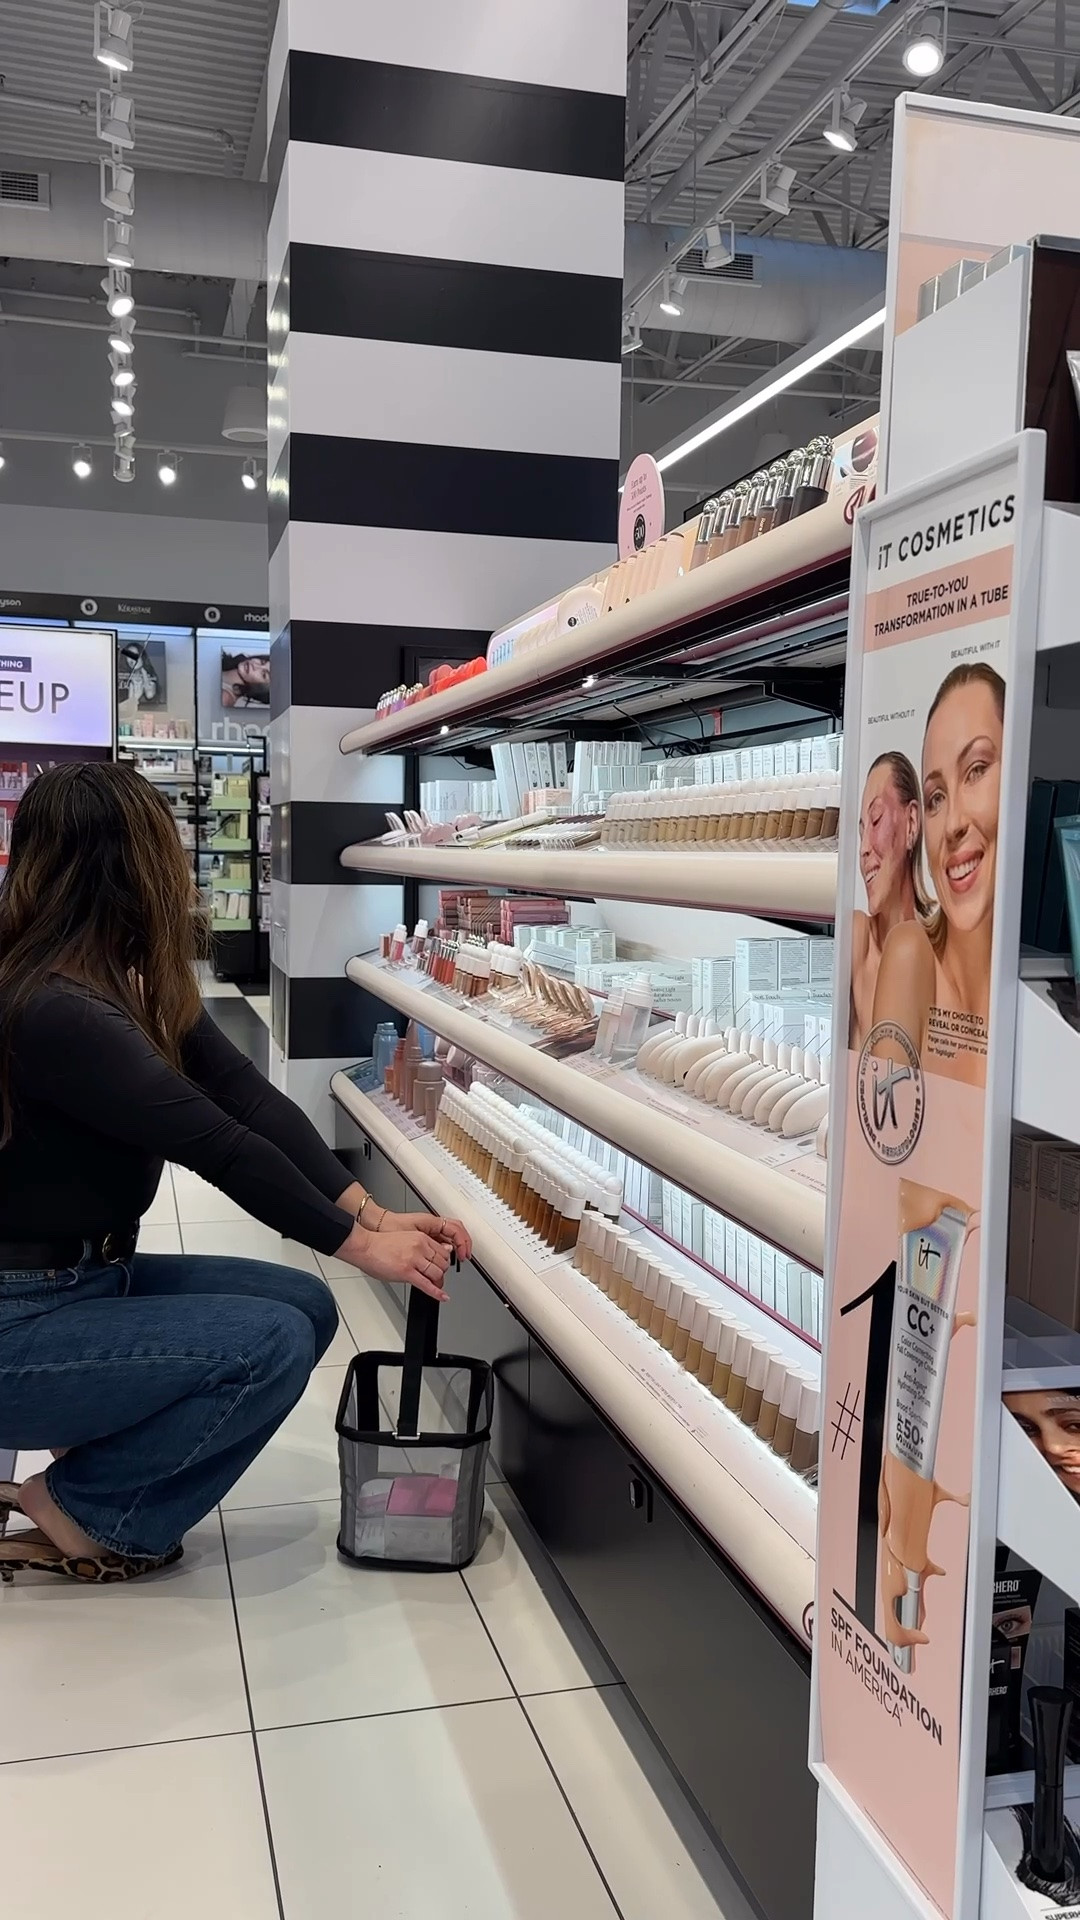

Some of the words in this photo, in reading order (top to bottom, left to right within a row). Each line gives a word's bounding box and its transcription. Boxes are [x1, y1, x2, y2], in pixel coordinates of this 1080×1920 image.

[898, 495, 1015, 562] COSMETICS
[906, 576, 969, 608] TRUE-TO-YOU
[874, 602, 954, 637] TRANSFORMATION
[957, 596, 967, 611] IN
[970, 594, 977, 608] A
[981, 584, 1009, 606] TUBE
[950, 646, 978, 659] BEAUTIFUL
[980, 641, 995, 652] WITH
[995, 640, 1001, 650] IT
[868, 713, 890, 725] BEAUTIFUL
[890, 710, 910, 722] WITHOUT
[910, 709, 916, 718] IT
[928, 1018, 950, 1031] REVEAL
[951, 1022, 960, 1032] OR
[942, 1009, 951, 1019] MY
[952, 1010, 974, 1025] CHOICE
[975, 1015, 984, 1026] TO
[918, 1238, 941, 1270] it
[907, 1304, 935, 1338] CC+
[896, 1412, 904, 1443] SPF
[831, 1631, 842, 1658] IN
[831, 1607, 852, 1641] SPF
[856, 1632, 942, 1746] FOUNDATION
